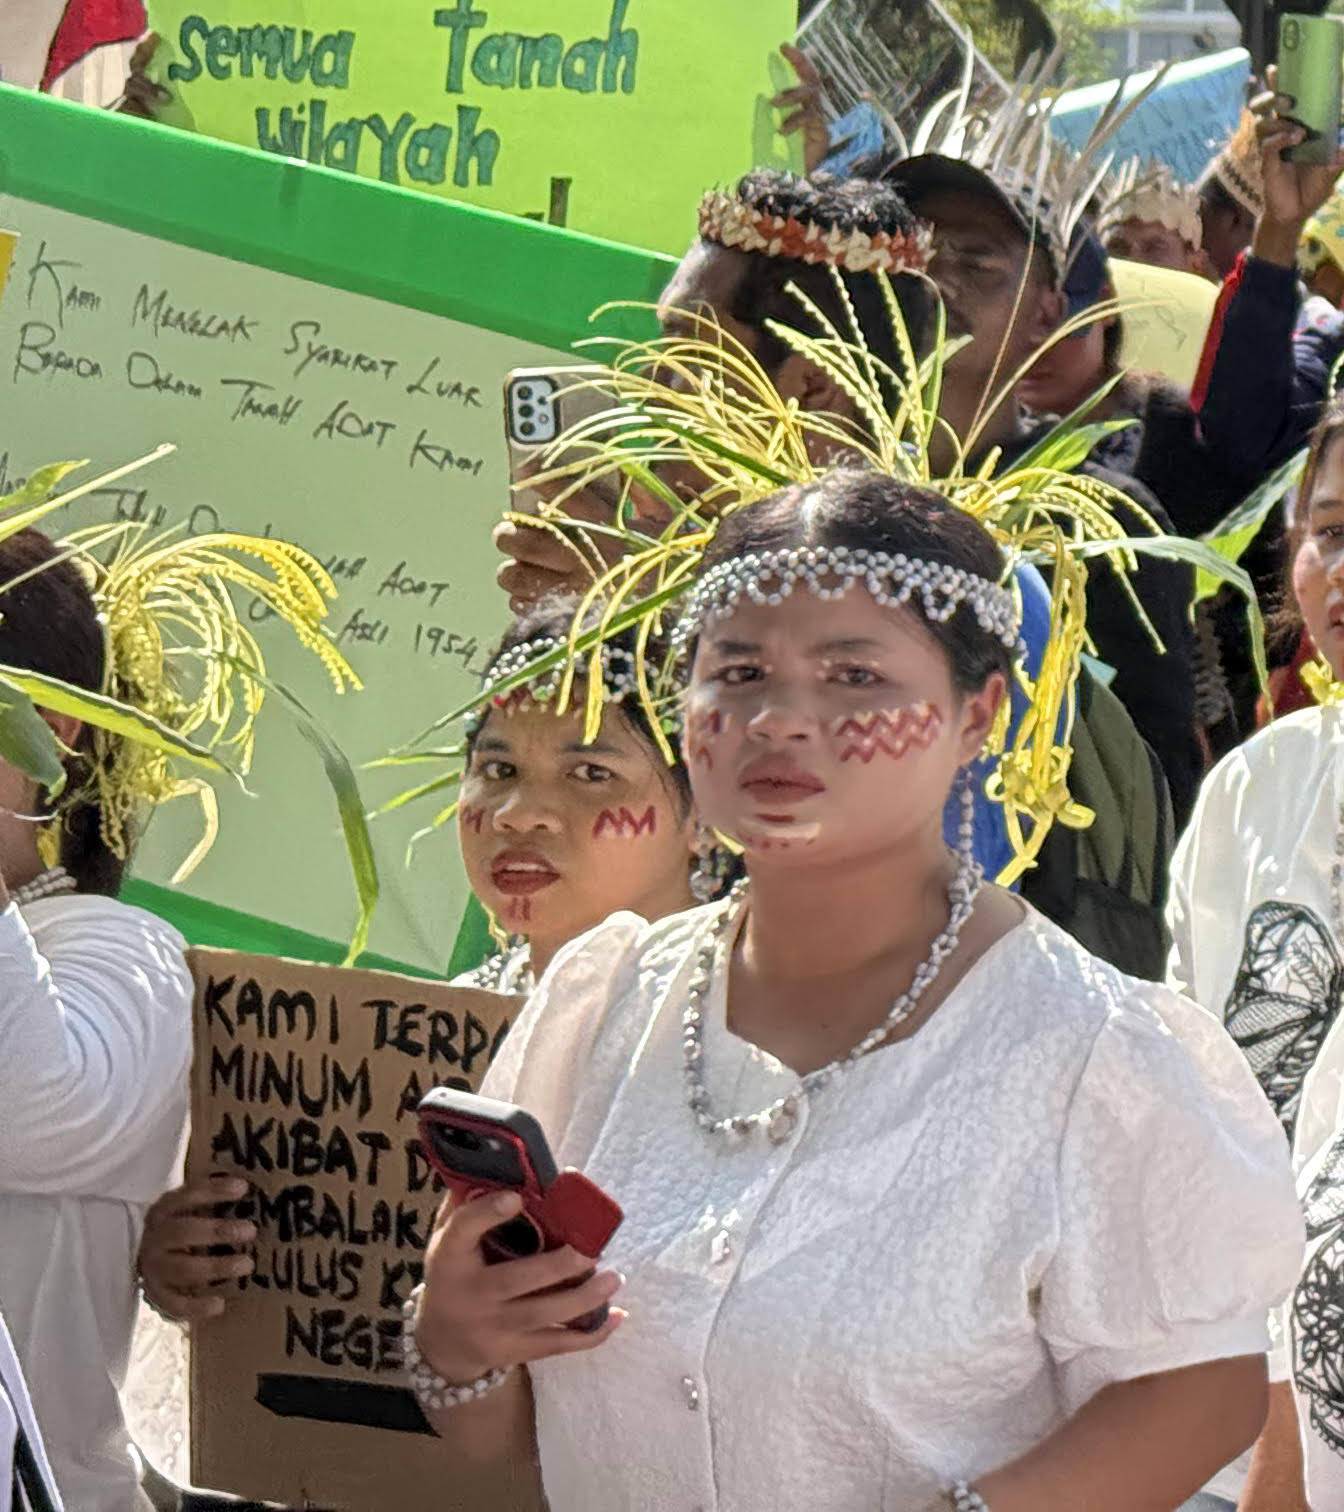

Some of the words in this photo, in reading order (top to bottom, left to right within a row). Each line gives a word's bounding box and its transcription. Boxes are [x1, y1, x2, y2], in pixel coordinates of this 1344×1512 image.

[169, 14, 354, 88] semua
[204, 973, 338, 1046] KAMI
[208, 1043, 373, 1121] MINUM
[211, 1111, 392, 1186] AKIBAT
